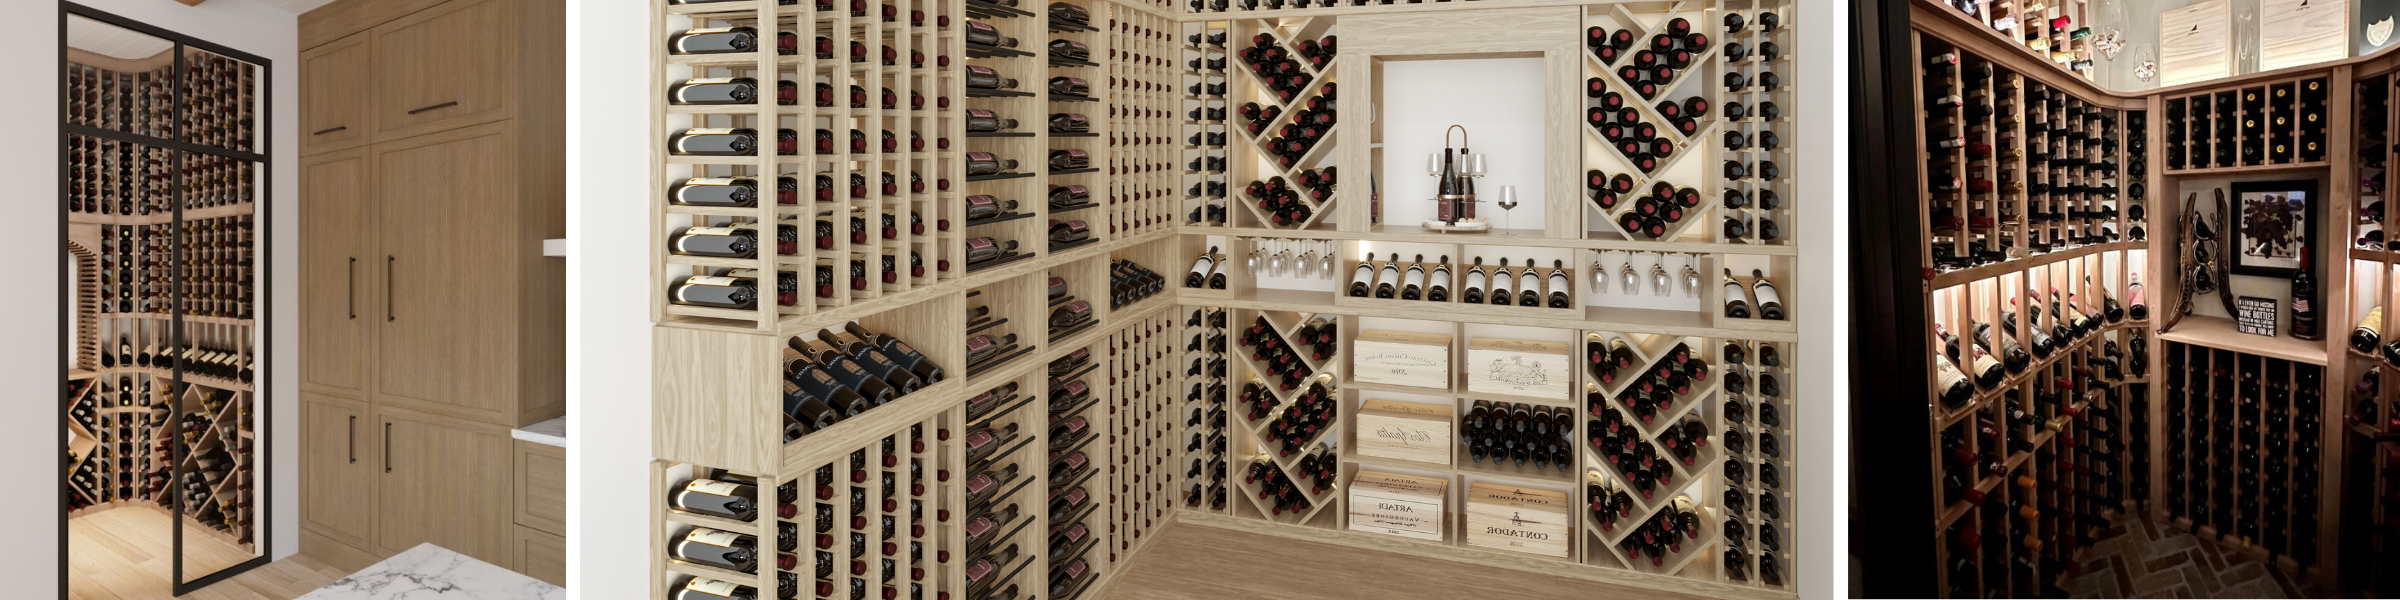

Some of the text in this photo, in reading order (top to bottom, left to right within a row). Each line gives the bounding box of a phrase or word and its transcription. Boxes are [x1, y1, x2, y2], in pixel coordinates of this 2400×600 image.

[2239, 310, 2274, 320] WINE BOTTLES
[2239, 325, 2245, 333] TO
[2245, 325, 2257, 333] LOOK
[2267, 329, 2274, 337] ME
